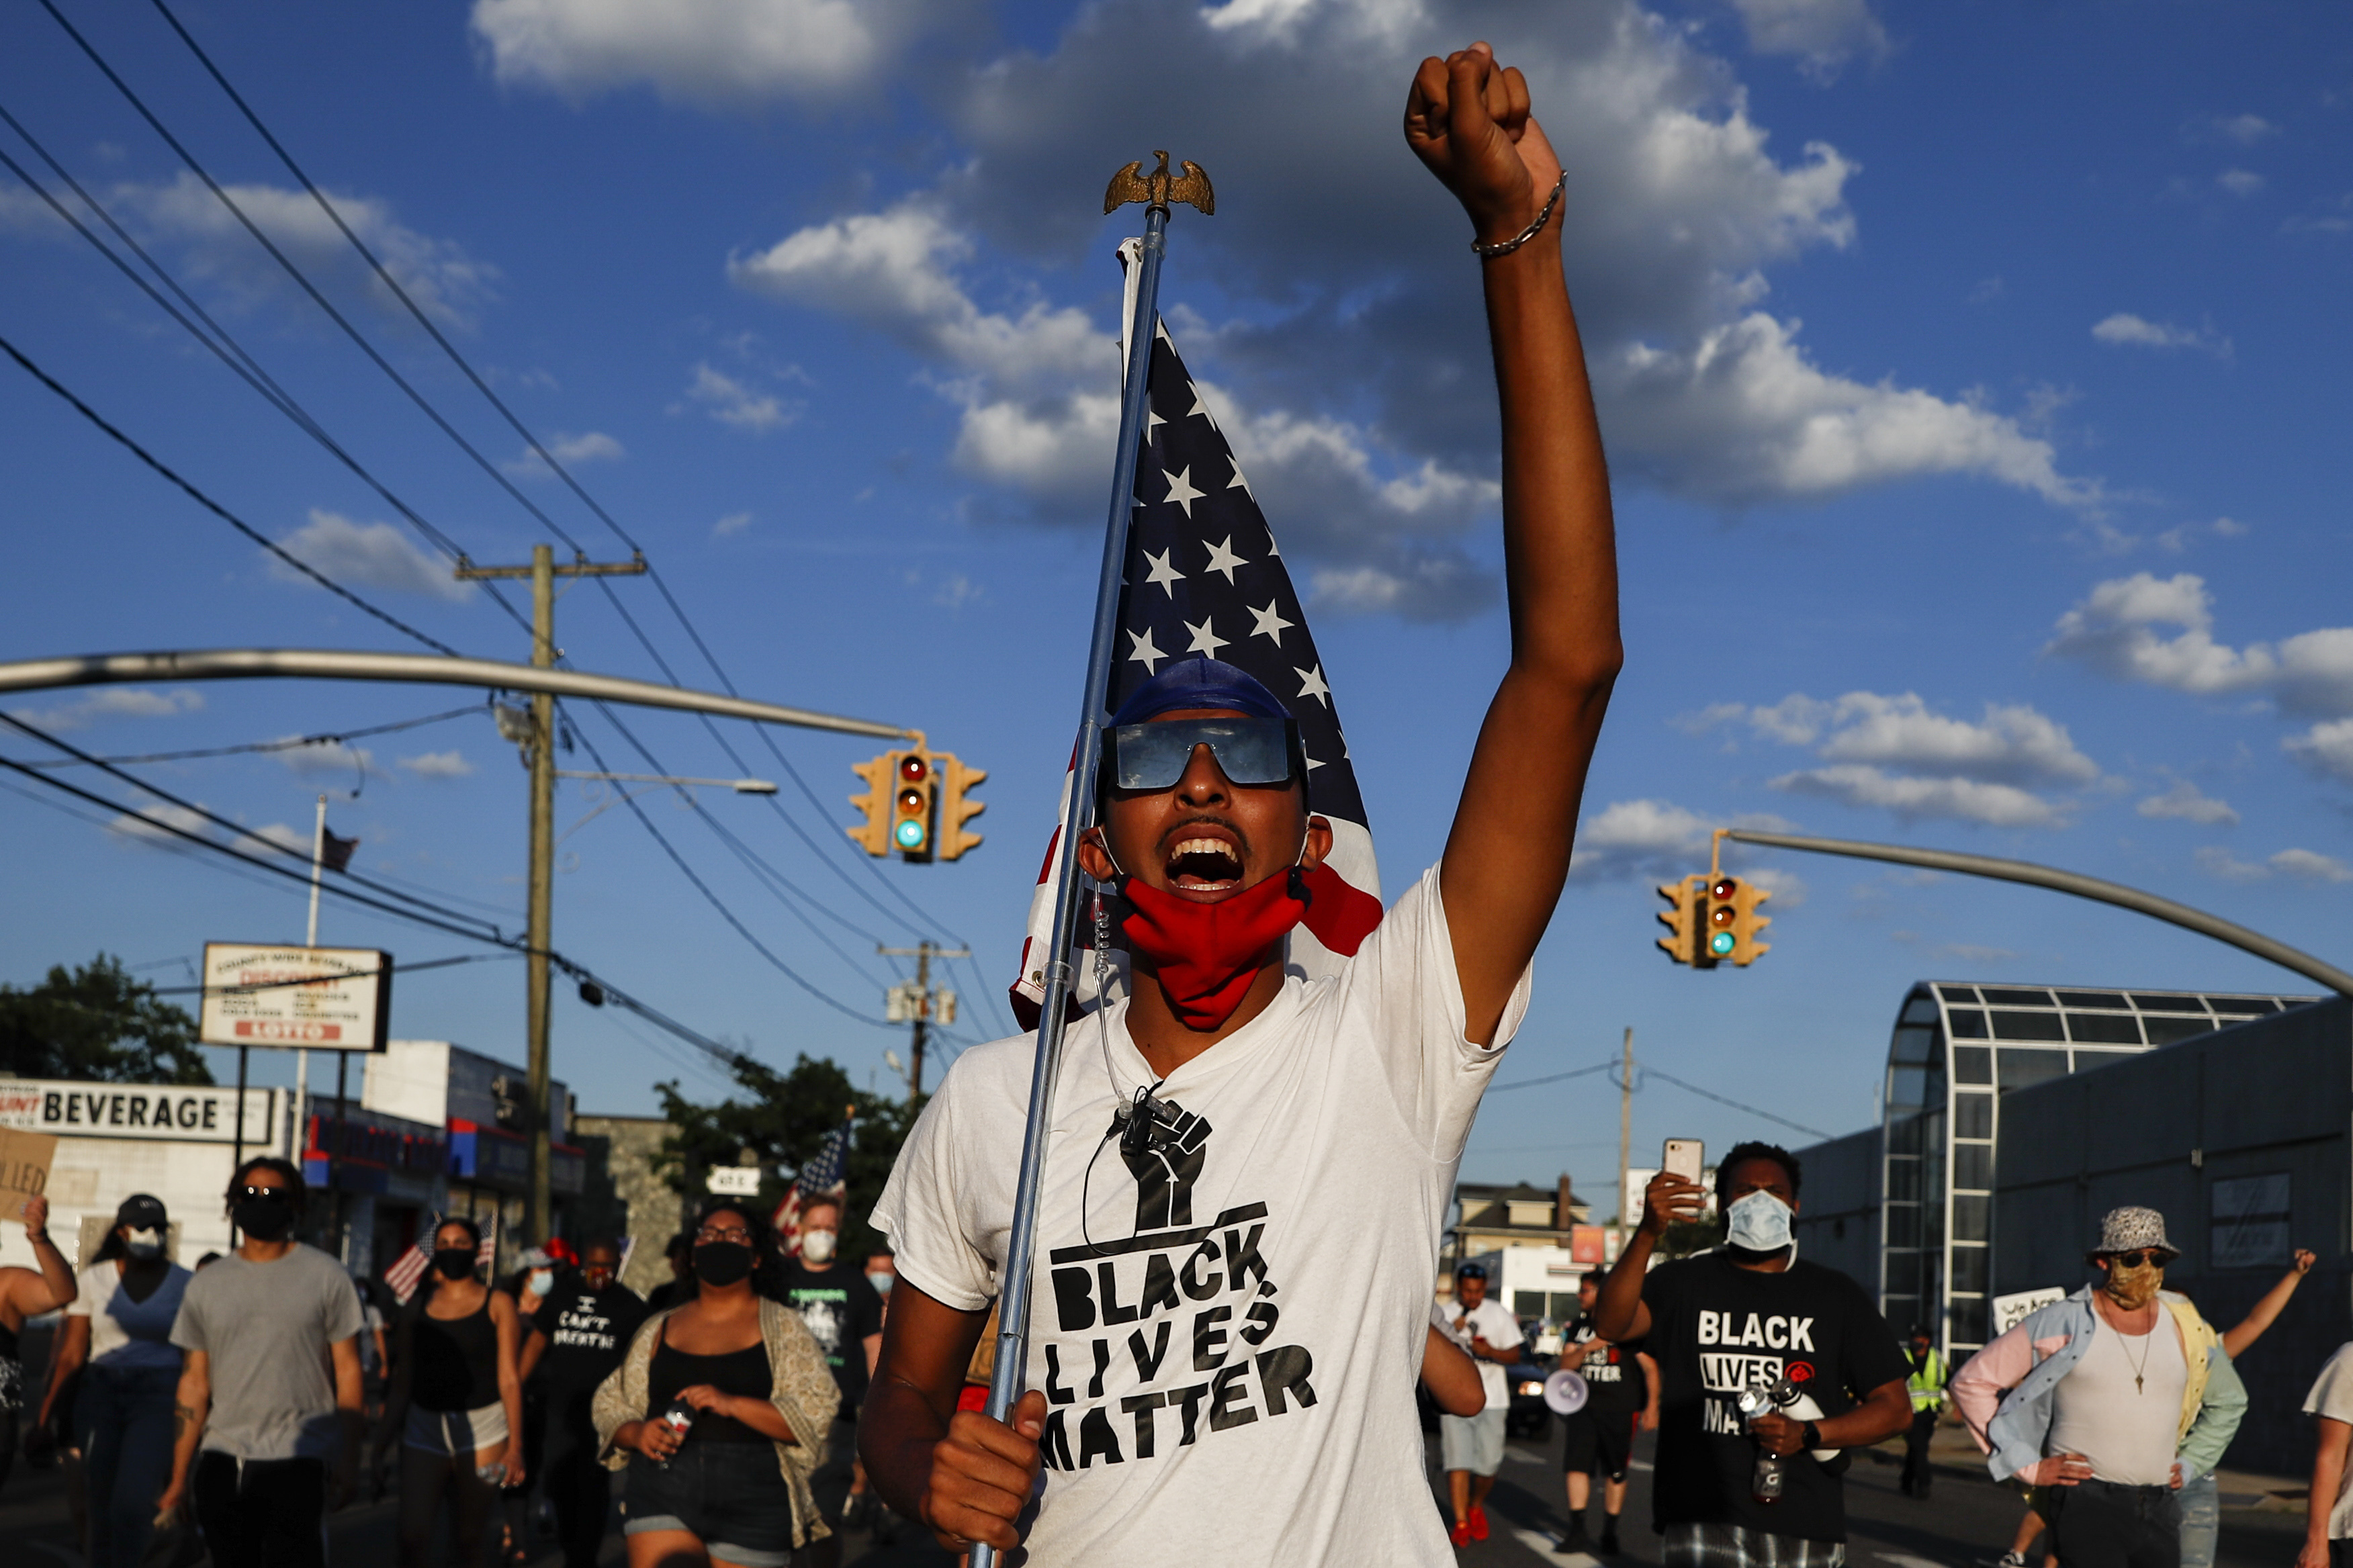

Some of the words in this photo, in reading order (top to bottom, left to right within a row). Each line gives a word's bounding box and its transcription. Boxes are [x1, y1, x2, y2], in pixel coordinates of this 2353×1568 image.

[251, 1021, 324, 1040] LOTTO
[44, 1092, 218, 1129] BEVERAGE
[1051, 1223, 1268, 1332] BLACK
[1045, 1280, 1280, 1405] LIVES
[1698, 1309, 1815, 1352] BLACK
[1581, 1365, 1622, 1382] TTER
[1702, 1357, 1779, 1388] LIVES
[1038, 1344, 1319, 1471] MATTER
